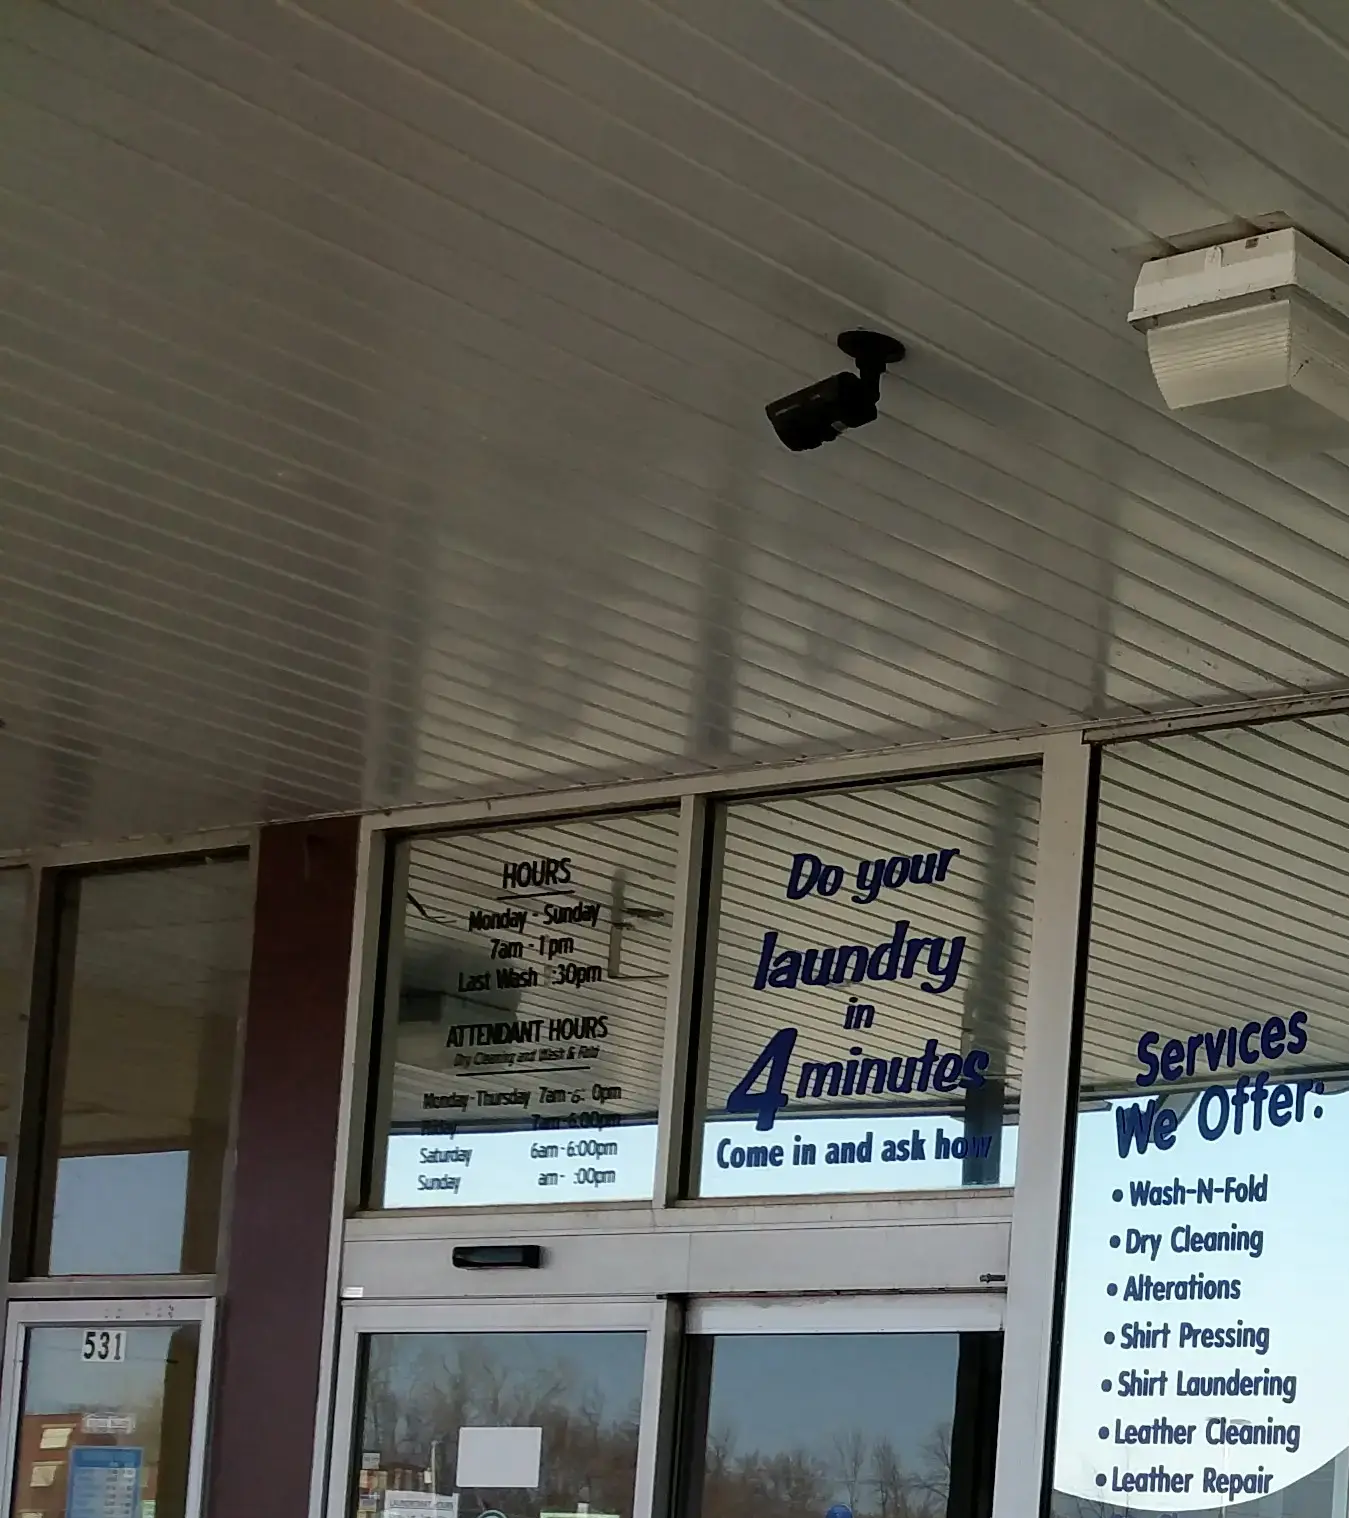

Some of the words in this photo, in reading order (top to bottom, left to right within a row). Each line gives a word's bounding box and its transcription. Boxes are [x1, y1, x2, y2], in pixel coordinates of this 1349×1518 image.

[503, 858, 571, 889] HOURS
[786, 853, 844, 900] Do
[852, 848, 960, 904] your
[468, 908, 528, 933] Monday
[543, 901, 601, 927] Sunday
[490, 938, 523, 960] 7am
[753, 920, 966, 993] laundry
[458, 971, 491, 992] Last
[496, 967, 538, 989] Wash
[843, 997, 875, 1029] in
[447, 1019, 544, 1048] ATTENDANT
[549, 1016, 609, 1041] HOURS
[1135, 1010, 1308, 1087] Services
[726, 1028, 797, 1130] 4
[796, 1039, 989, 1098] minutes
[1116, 1098, 1177, 1158] We
[1199, 1072, 1325, 1141] Offer:
[420, 1146, 473, 1167] Saturday
[717, 1138, 784, 1168] Come
[793, 1135, 816, 1165] in
[825, 1132, 872, 1164] and
[881, 1129, 926, 1161] ask
[935, 1128, 992, 1159] how
[417, 1174, 461, 1194] Sunday
[1130, 1174, 1268, 1207] Wash-N-Fold
[1125, 1228, 1161, 1261] Dry
[1171, 1223, 1264, 1258] Cleaning
[1123, 1273, 1241, 1302] Alterations
[82, 1331, 125, 1361] 531
[1120, 1322, 1171, 1350] Shirt
[1179, 1320, 1270, 1355] Pressing
[1118, 1369, 1168, 1398] Shirt
[1177, 1368, 1297, 1403] Laundering
[1115, 1418, 1196, 1446] Leather
[1206, 1417, 1300, 1452] Cleaning
[1112, 1466, 1193, 1494] Leather
[1203, 1466, 1273, 1501] Repair
